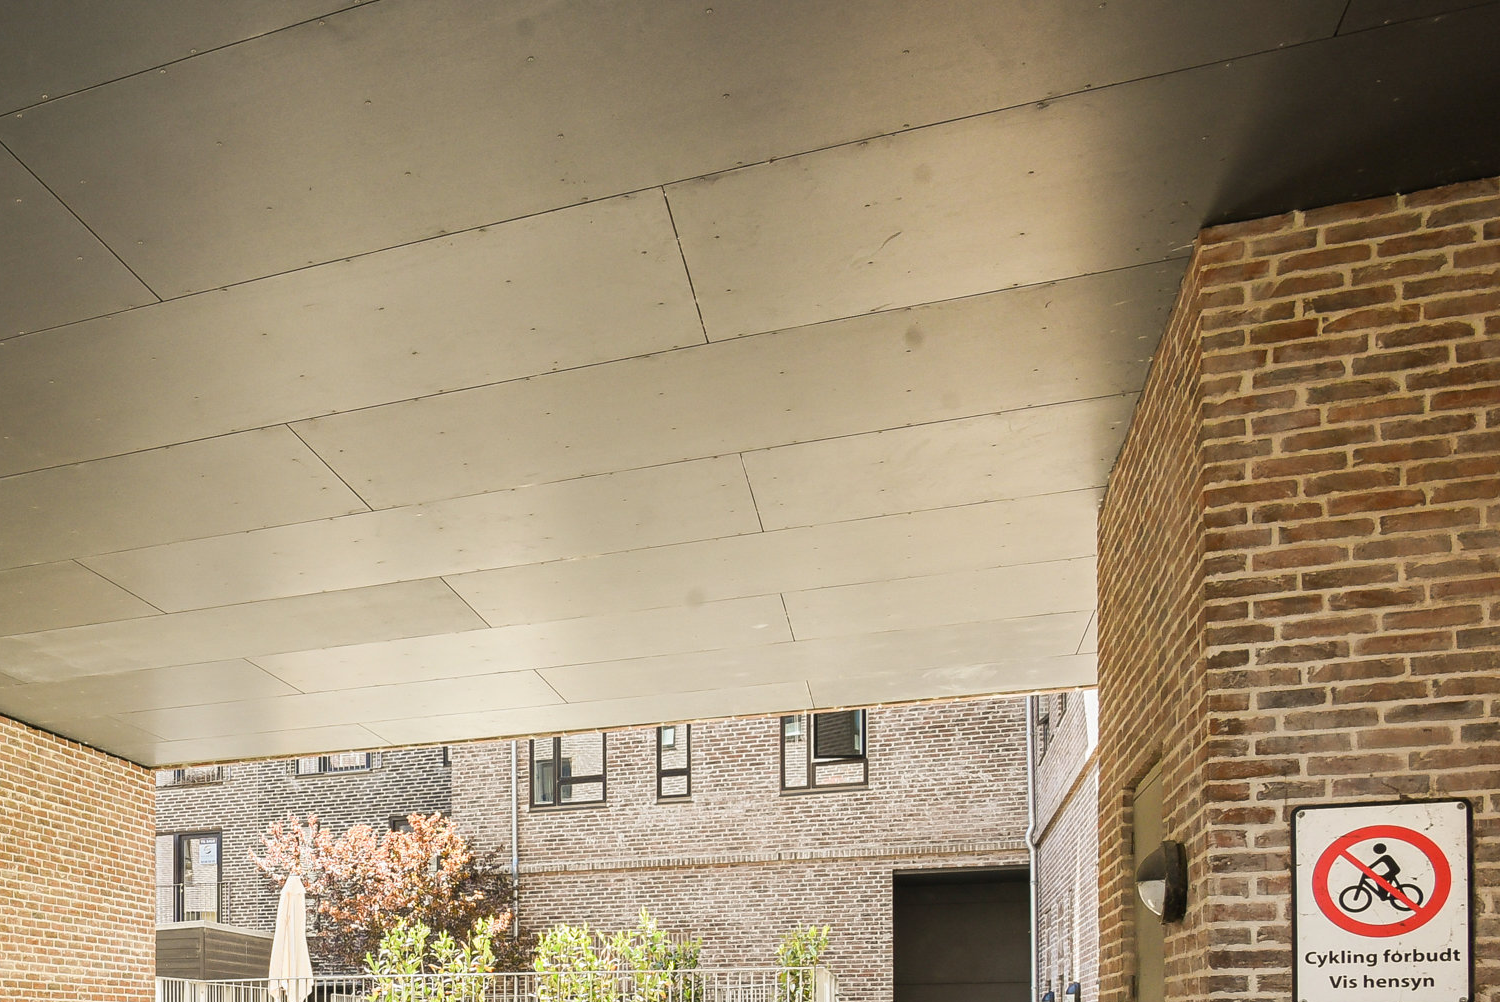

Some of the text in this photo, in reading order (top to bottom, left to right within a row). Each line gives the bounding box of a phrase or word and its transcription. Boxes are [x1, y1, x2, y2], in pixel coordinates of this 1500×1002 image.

[1305, 948, 1461, 968] Cykling forbudt
[1329, 974, 1435, 991] Vis hensyn
